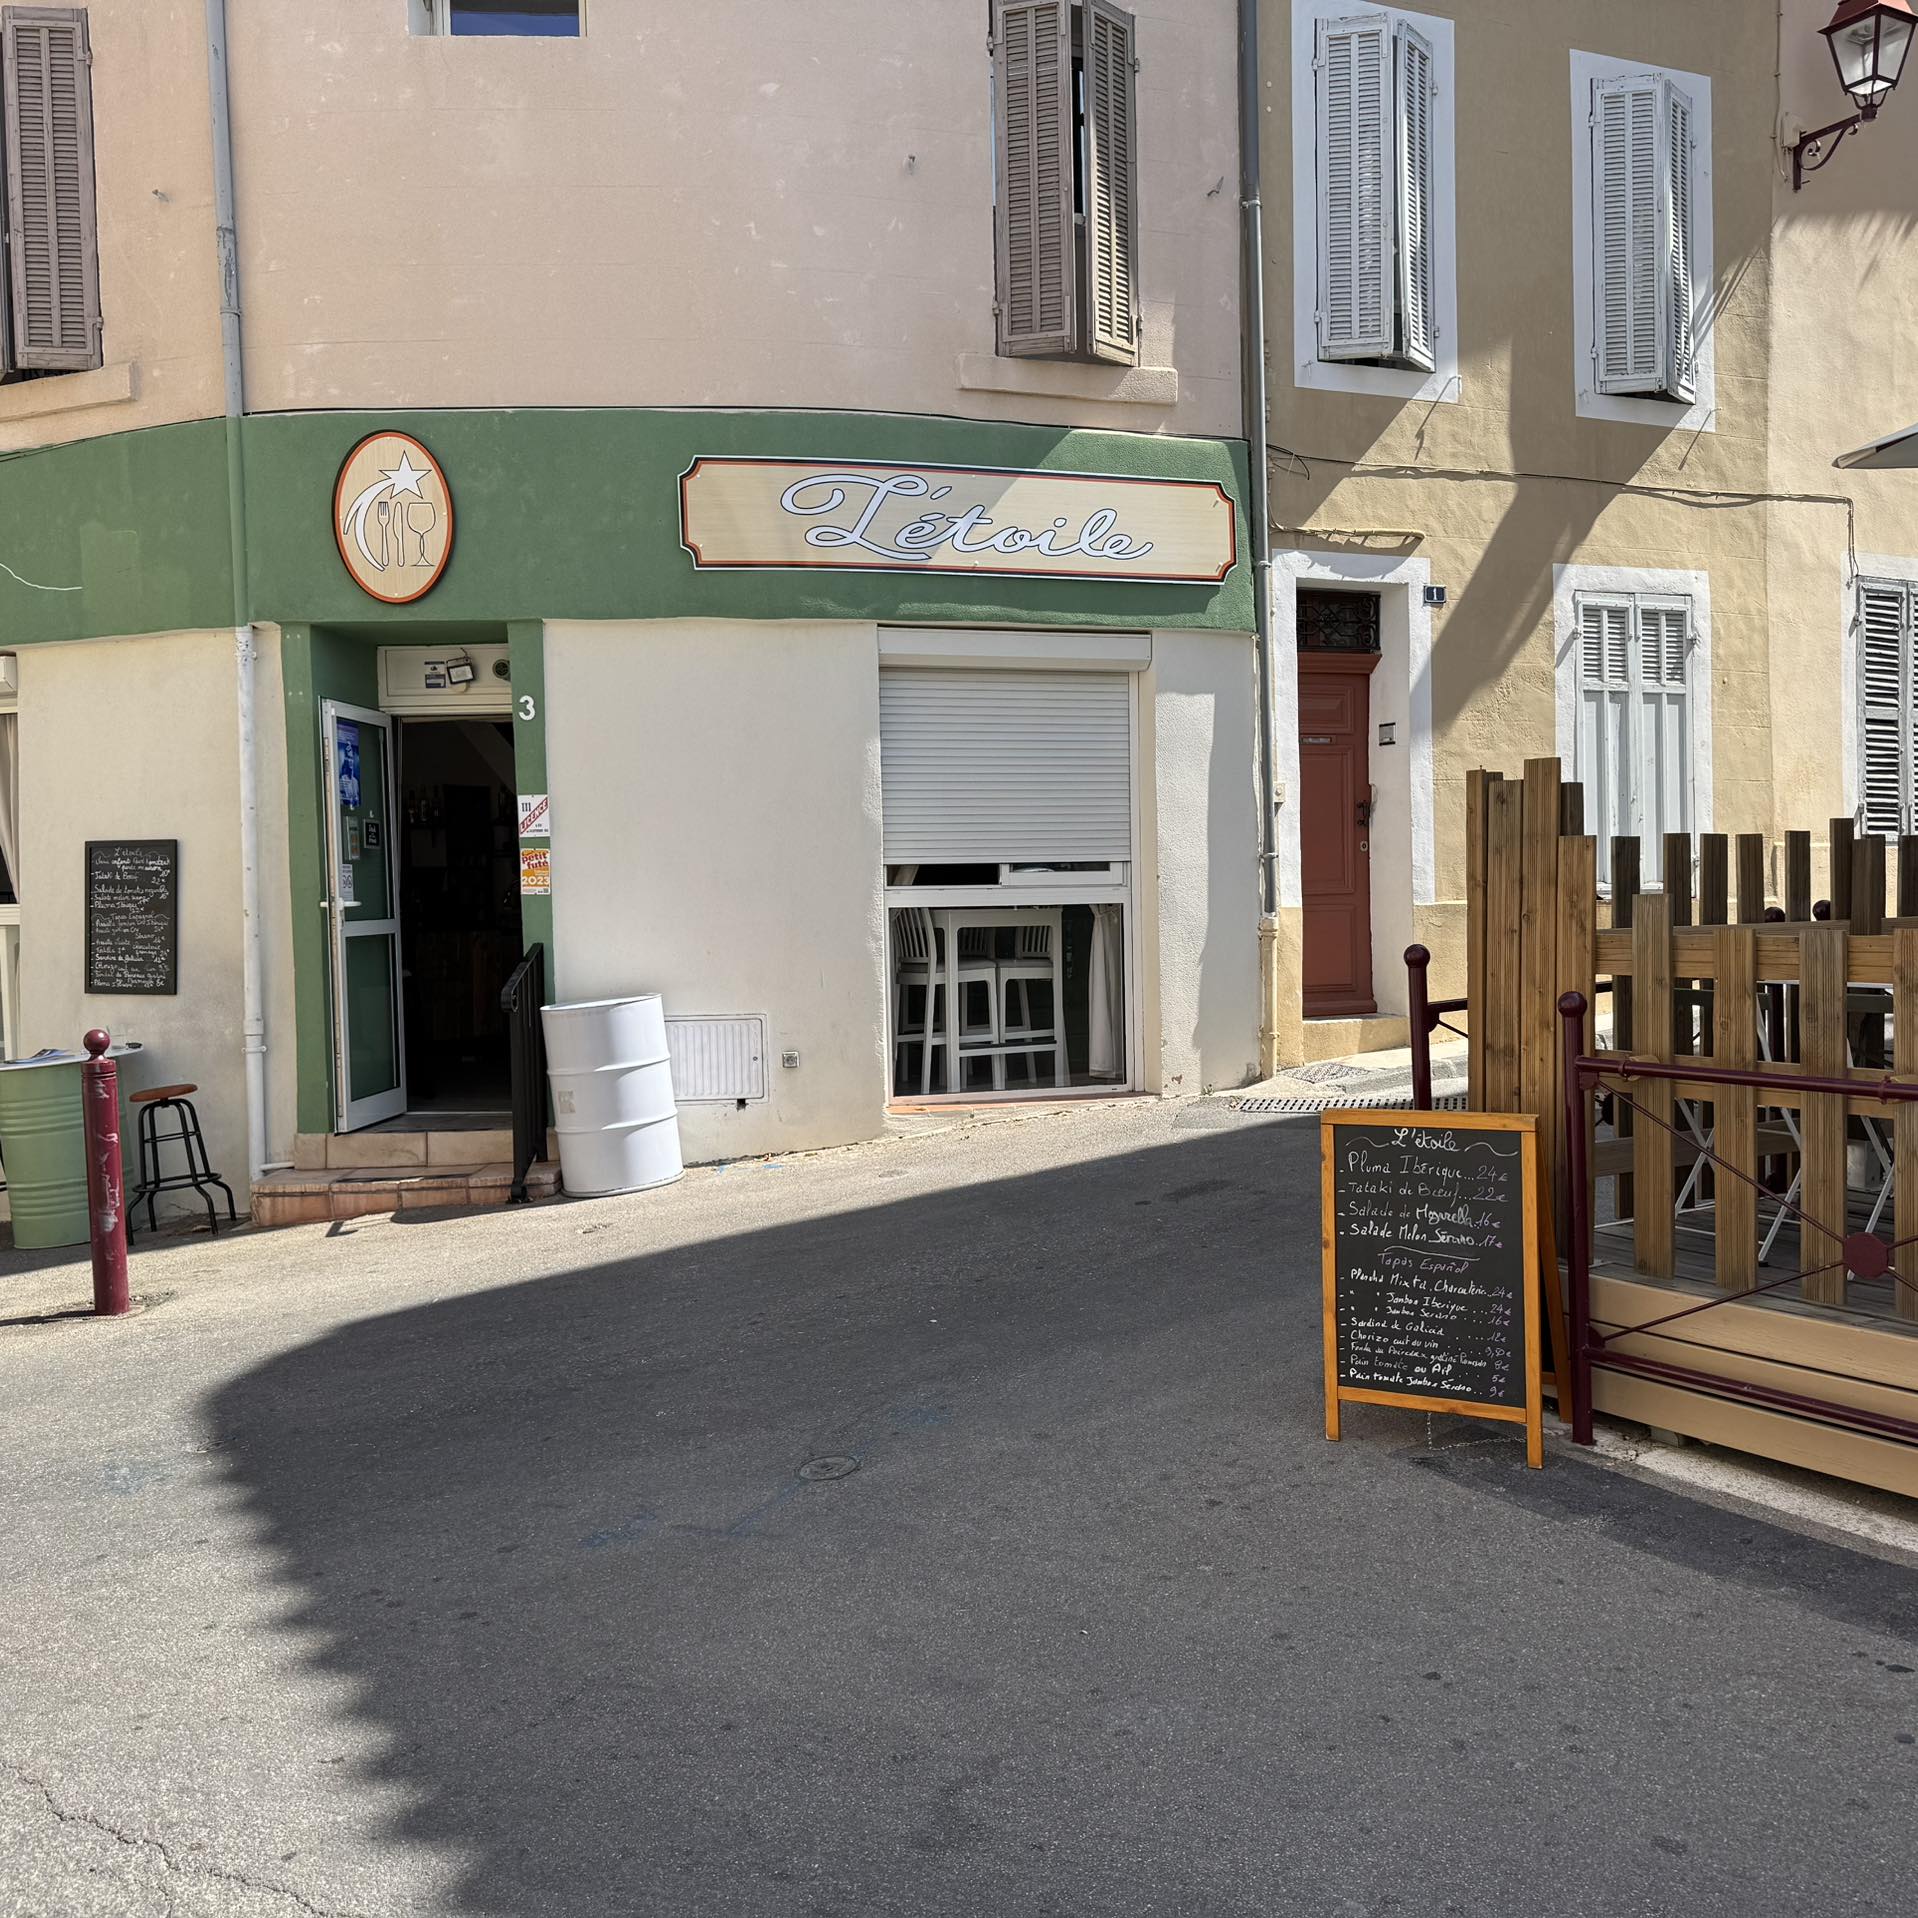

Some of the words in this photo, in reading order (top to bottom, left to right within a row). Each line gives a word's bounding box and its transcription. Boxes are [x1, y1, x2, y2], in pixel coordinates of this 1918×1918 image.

[781, 473, 1153, 562] L'étoile
[1433, 587, 1438, 601] 1
[518, 695, 536, 721] 3
[520, 798, 549, 833] LICENCE
[522, 851, 548, 864] petit
[527, 860, 549, 870] futé
[522, 876, 550, 885] 2023
[1391, 1127, 1461, 1152] L'étoile
[1348, 1150, 1391, 1173] Pluma
[1348, 1180, 1393, 1194] Tataki
[1399, 1181, 1413, 1195] de
[1349, 1199, 1393, 1217] Salade
[1399, 1204, 1411, 1218] de
[1349, 1220, 1393, 1238] Salade
[1399, 1223, 1427, 1241] Melon
[1377, 1252, 1413, 1269] Tapas
[1386, 1292, 1419, 1305] Jambon
[1385, 1305, 1414, 1316] Jambon
[1350, 1329, 1389, 1343] Chorizo
[1424, 1339, 1439, 1349] vin
[1350, 1353, 1369, 1366] Pain
[1374, 1356, 1408, 1370] tomate
[1349, 1367, 1370, 1380] Pain
[1373, 1371, 1404, 1383] tomate
[1406, 1376, 1439, 1387] Jambon
